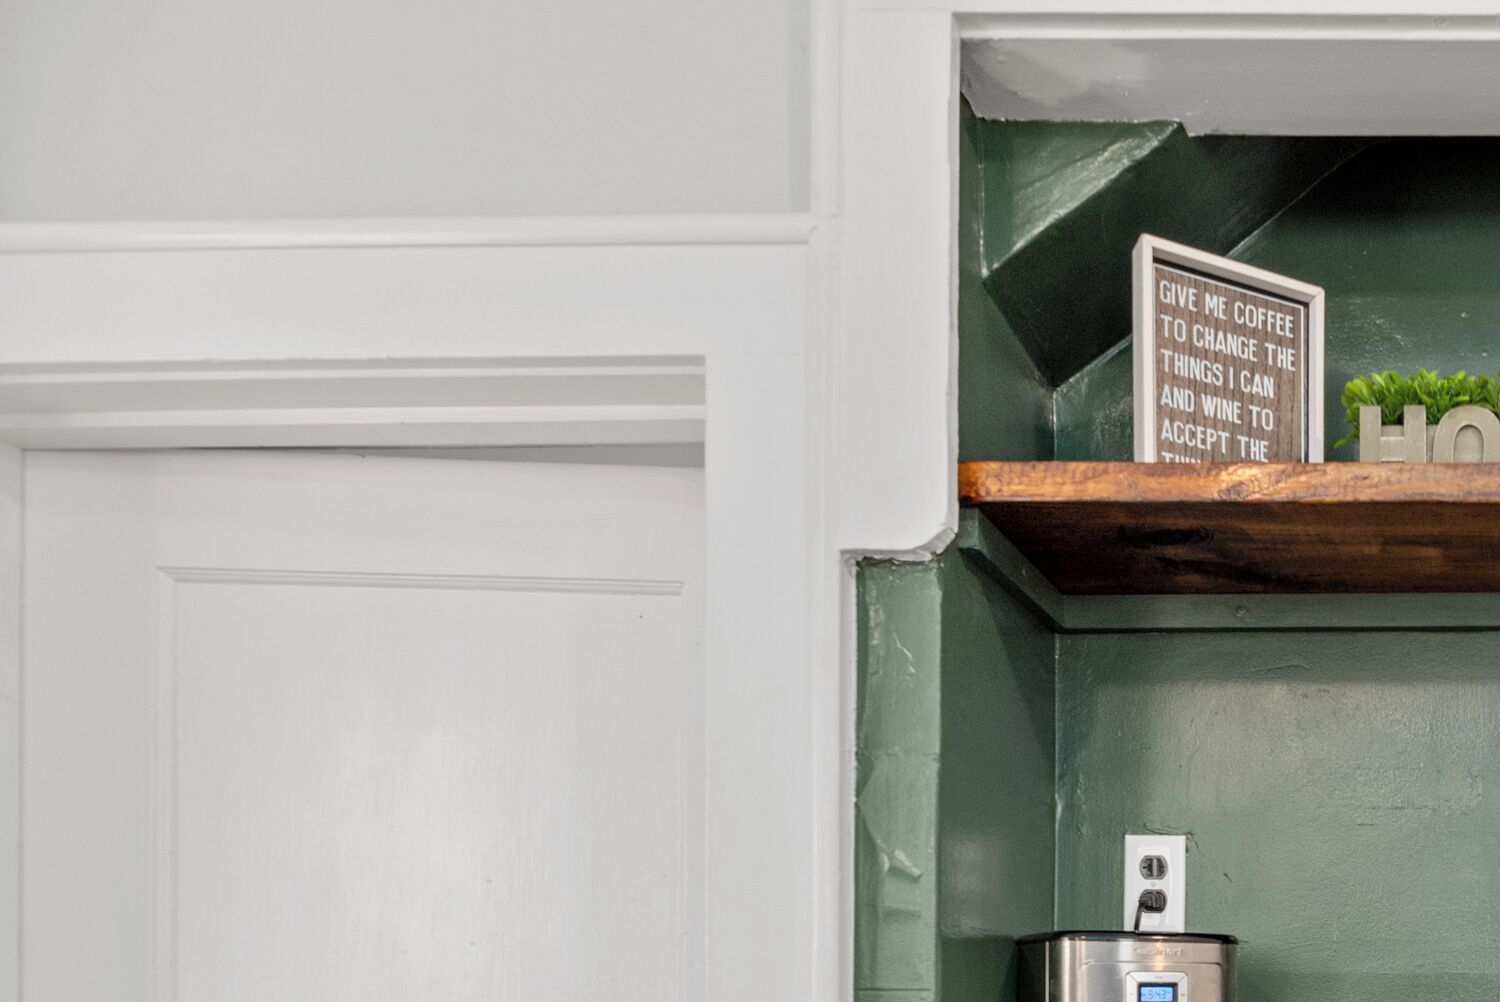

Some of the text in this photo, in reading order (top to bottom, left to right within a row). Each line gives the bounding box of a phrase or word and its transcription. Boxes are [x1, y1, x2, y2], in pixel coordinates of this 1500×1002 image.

[1159, 279, 1294, 338] GIVE ME COFFEE
[1160, 314, 1296, 371] TO CHANGE THE
[1160, 349, 1275, 399] THINGS I CAN
[1161, 384, 1274, 431] AND WINE TO
[1161, 418, 1269, 463] ACCEPT THE
